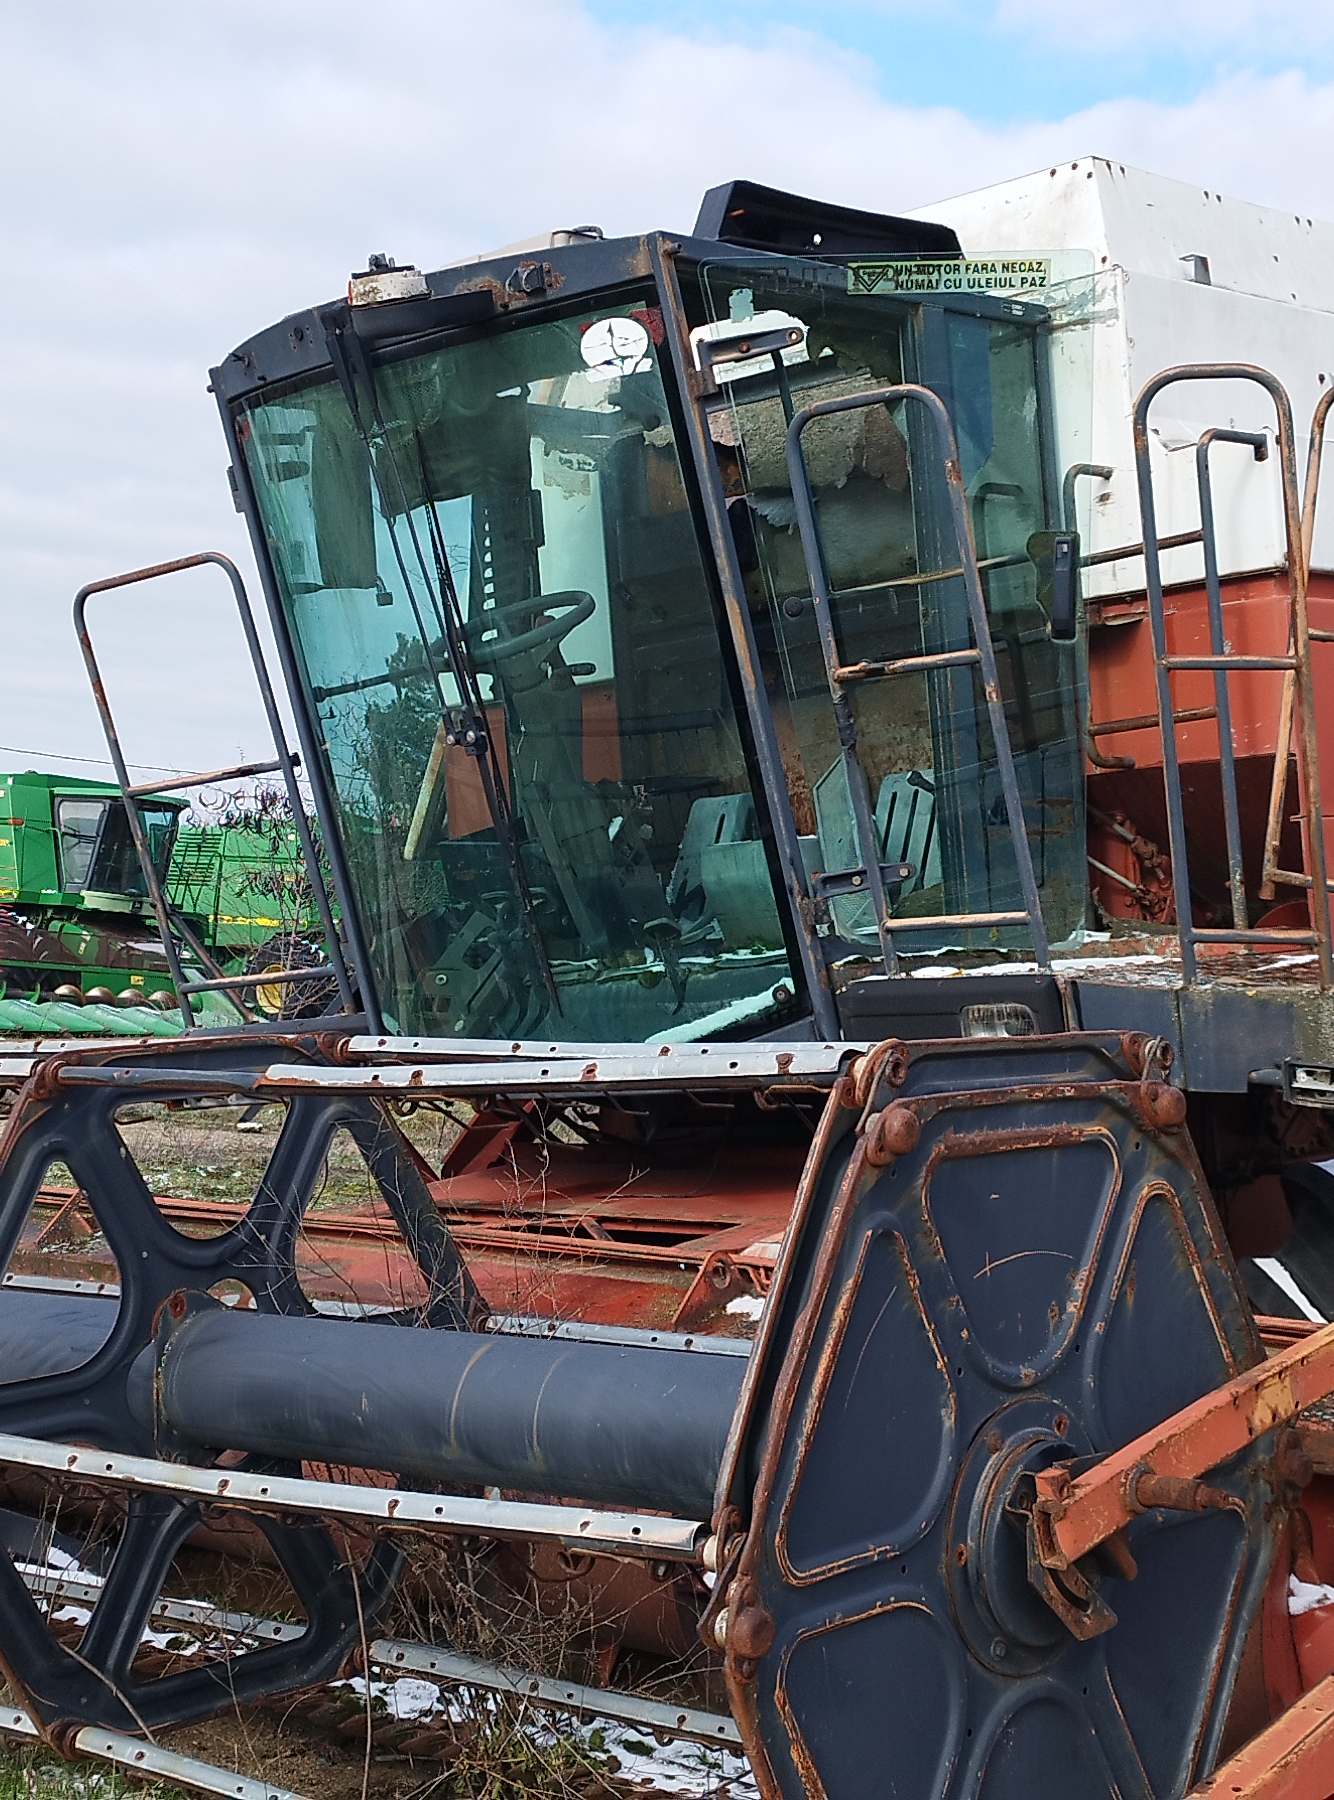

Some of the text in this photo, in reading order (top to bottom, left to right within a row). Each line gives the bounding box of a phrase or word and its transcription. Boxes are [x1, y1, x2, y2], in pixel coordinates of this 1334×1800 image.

[915, 263, 961, 276] MOTOR
[965, 262, 997, 275] FARA
[894, 276, 1047, 291] NUMAI CU ULEIUL PAZ
